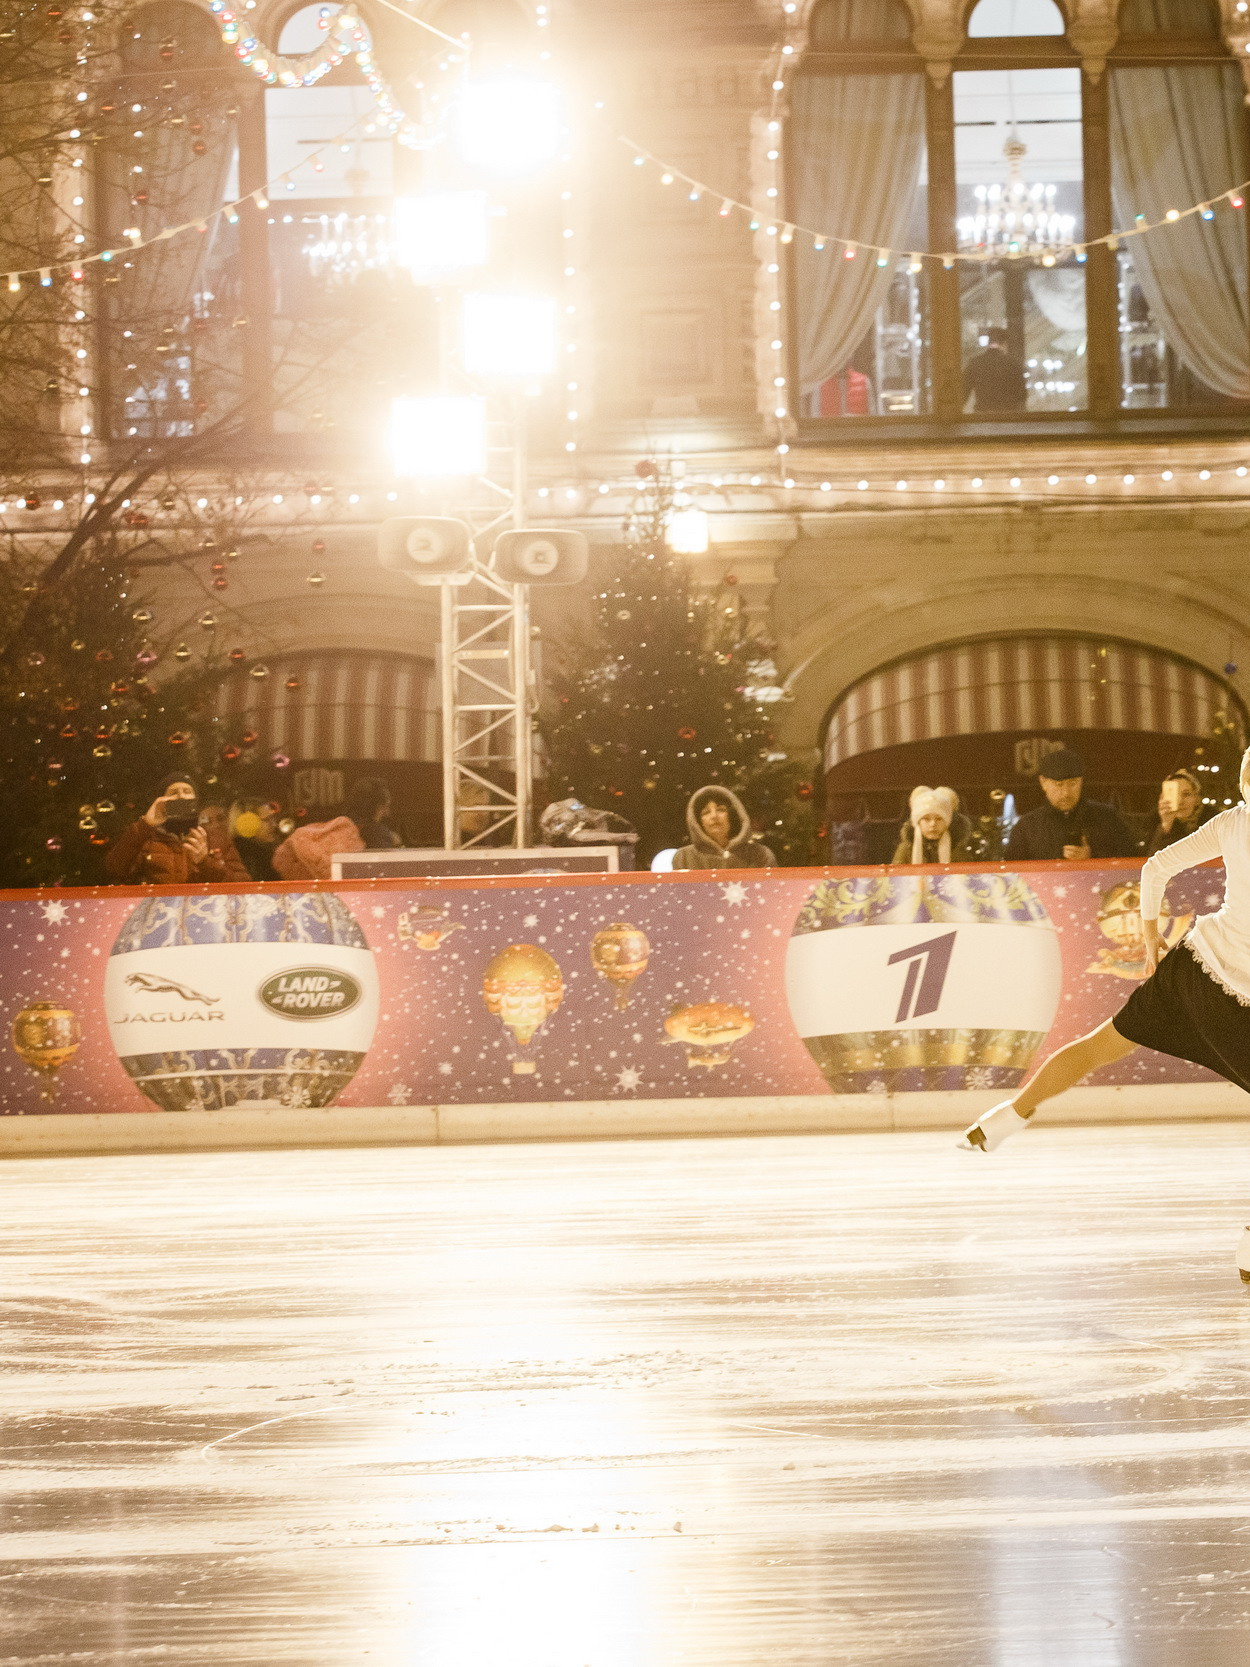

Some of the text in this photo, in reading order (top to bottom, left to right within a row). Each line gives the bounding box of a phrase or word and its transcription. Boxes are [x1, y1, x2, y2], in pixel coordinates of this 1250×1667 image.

[279, 976, 332, 992] LAND
[284, 992, 346, 1009] ROVER
[113, 1010, 226, 1025] JAGUAR
